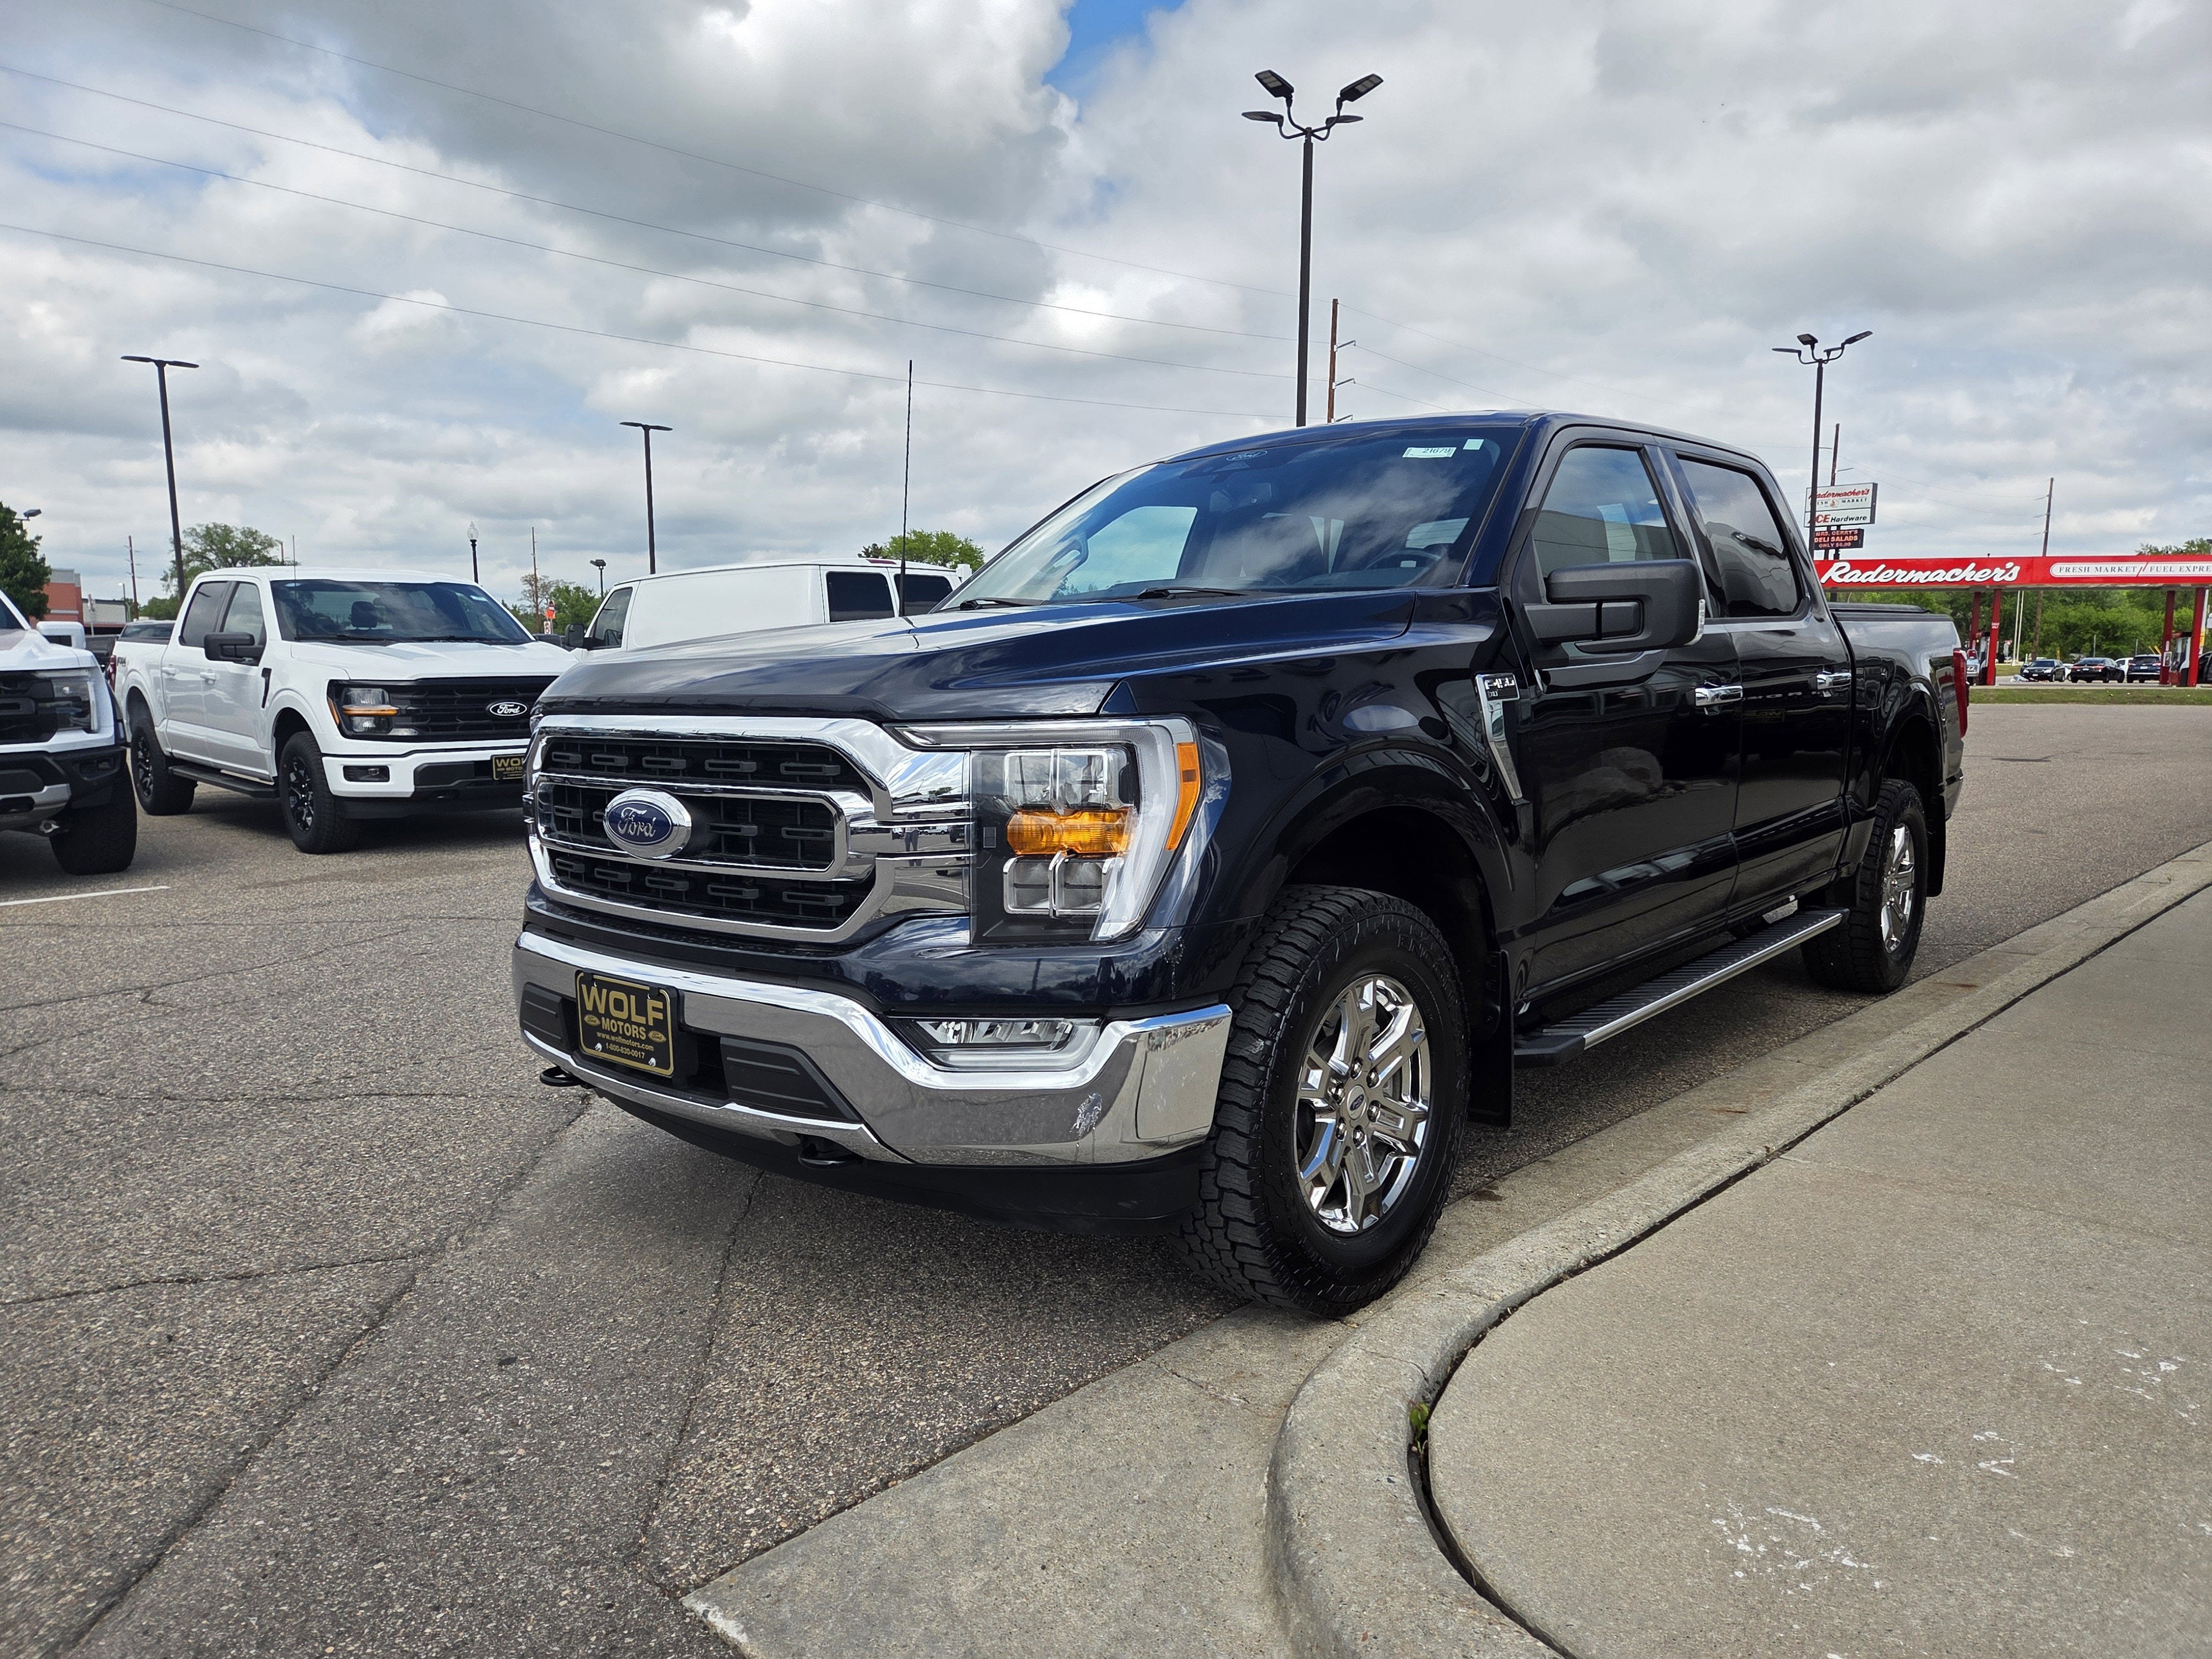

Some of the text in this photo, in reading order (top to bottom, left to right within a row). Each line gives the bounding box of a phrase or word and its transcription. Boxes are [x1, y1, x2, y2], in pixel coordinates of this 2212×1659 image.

[1808, 488, 1870, 499] adermacher's
[1807, 514, 1831, 524] CE
[1820, 561, 2021, 583] Radermacher's
[497, 704, 520, 714] Ford
[496, 758, 524, 767] WO
[617, 807, 656, 837] Ford
[581, 984, 664, 1026] WOLF
[602, 1016, 646, 1040] MOTORS
